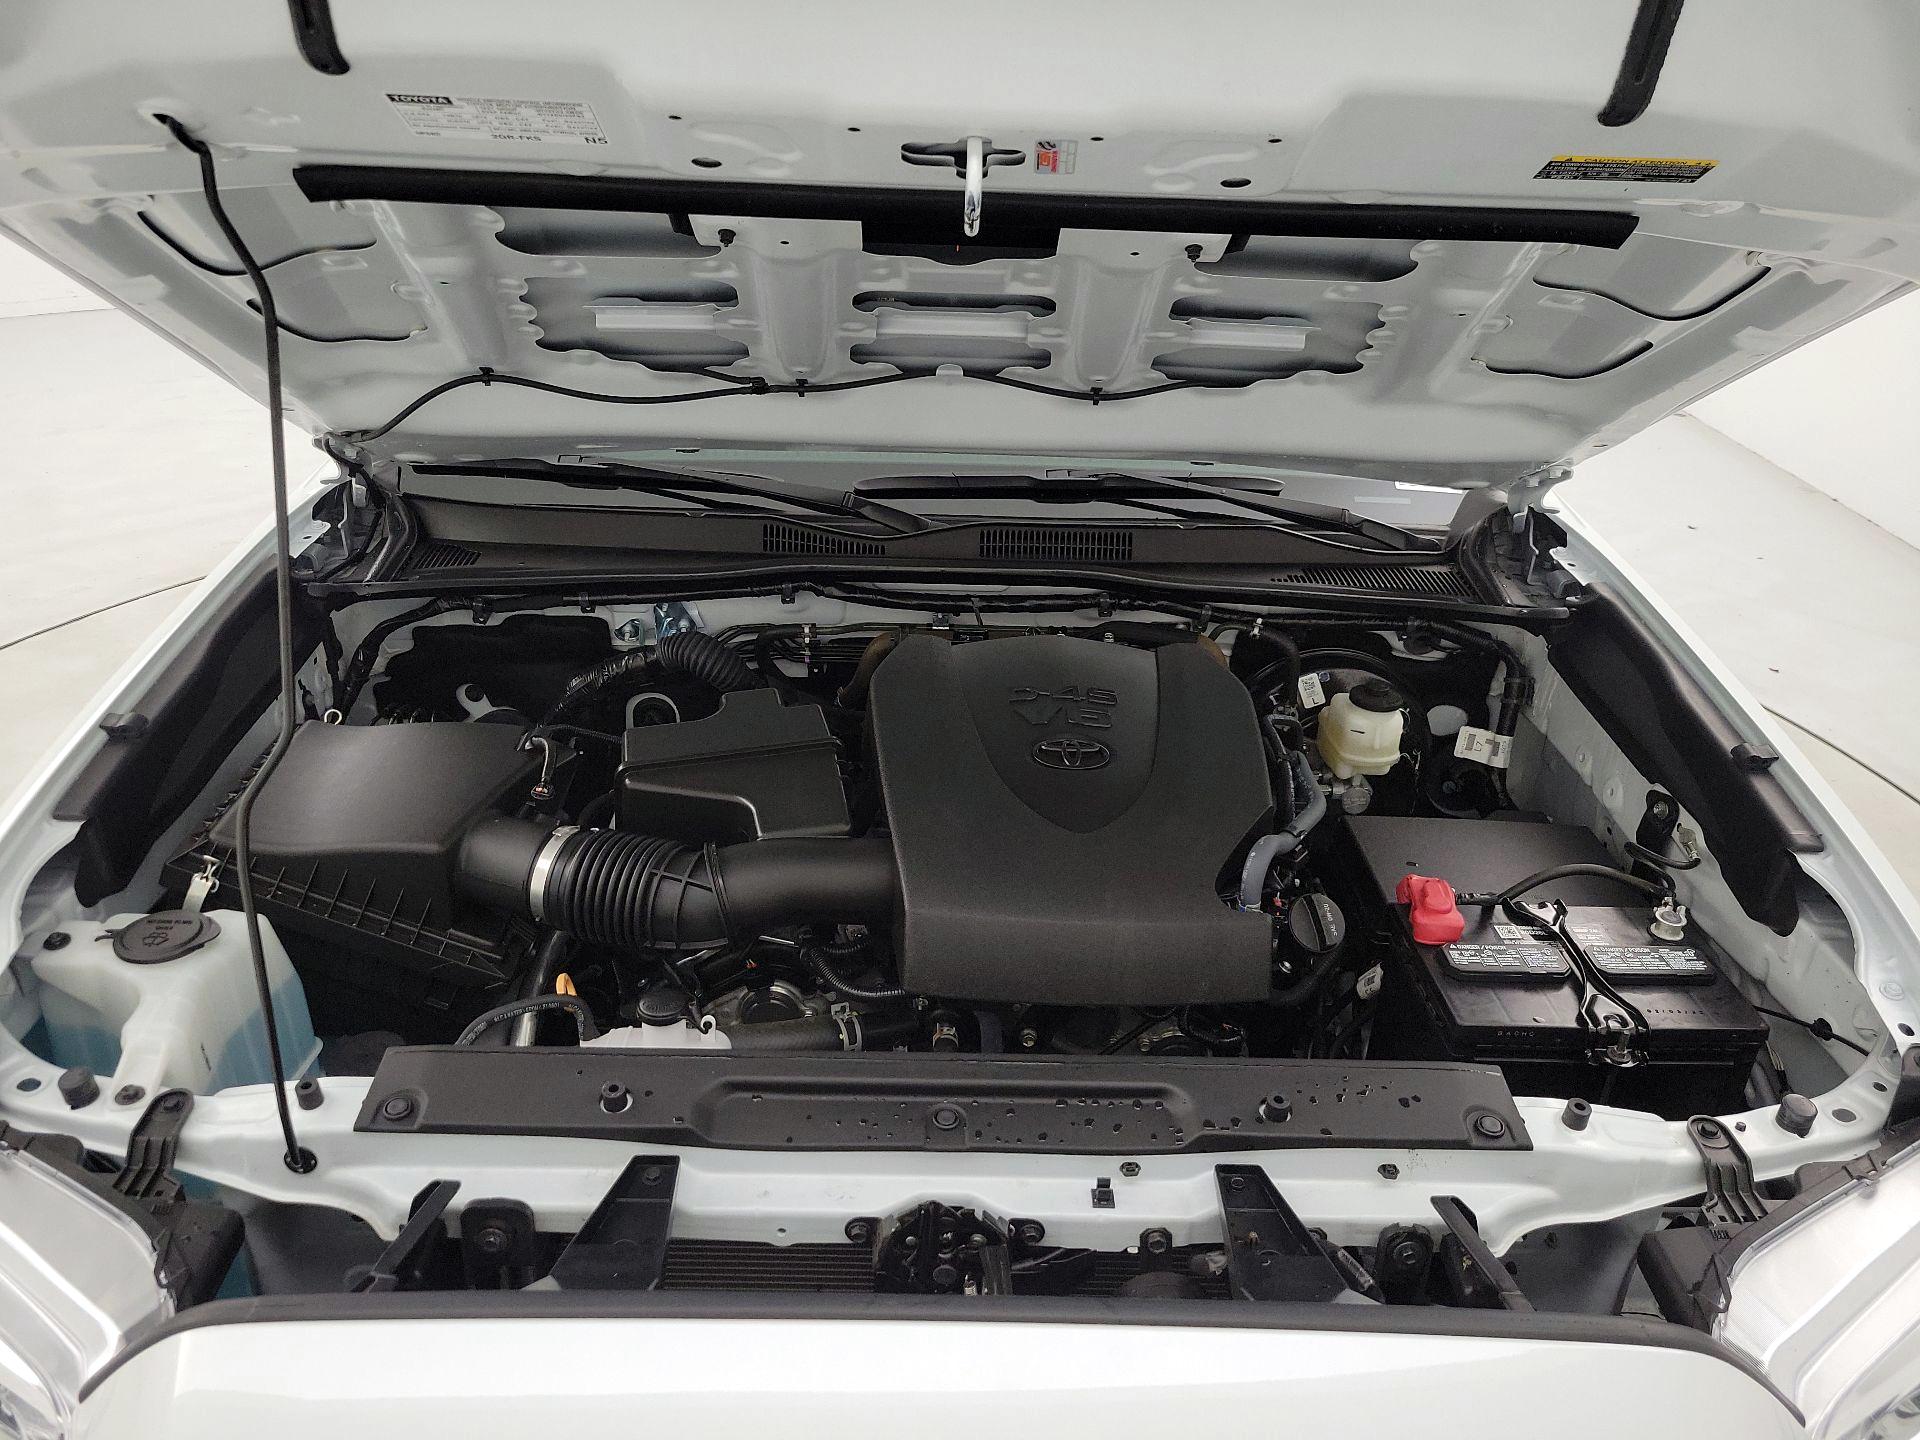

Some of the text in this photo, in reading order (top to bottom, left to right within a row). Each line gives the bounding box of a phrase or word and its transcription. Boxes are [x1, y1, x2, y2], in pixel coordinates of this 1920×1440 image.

[389, 94, 451, 104] TOYOTA
[584, 136, 608, 144] N5
[1011, 705, 1113, 729] V6
[1330, 923, 1338, 937] SAE
